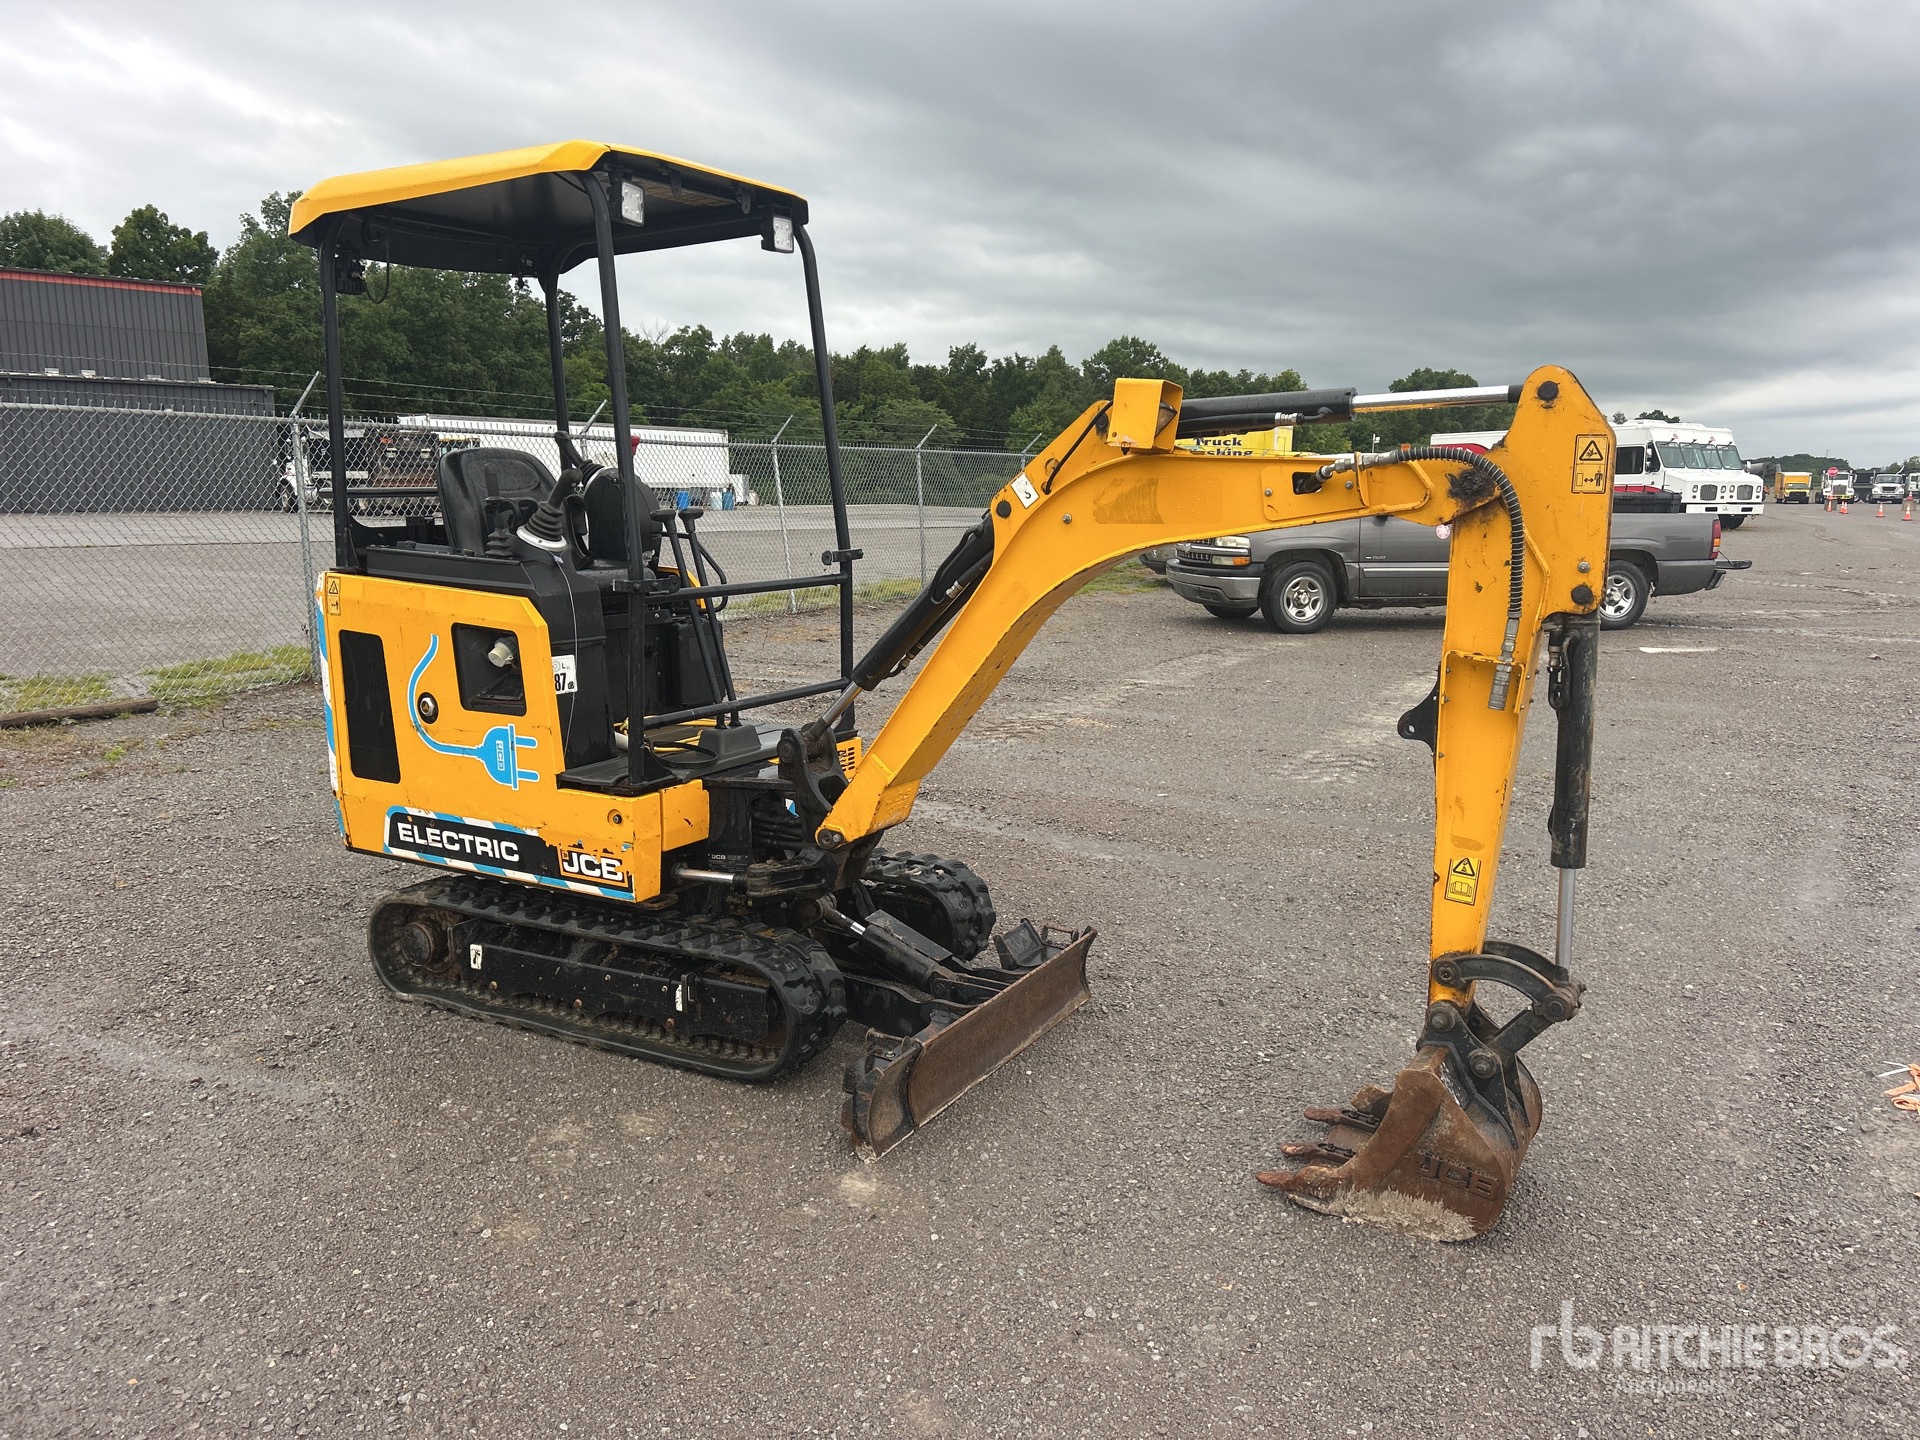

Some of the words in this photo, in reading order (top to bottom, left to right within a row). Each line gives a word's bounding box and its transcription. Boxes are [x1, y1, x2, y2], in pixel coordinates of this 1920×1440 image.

[1193, 437, 1243, 446] Truck
[554, 672, 566, 691] 87
[397, 822, 520, 862] ELECTRIC
[562, 851, 624, 881] JCB
